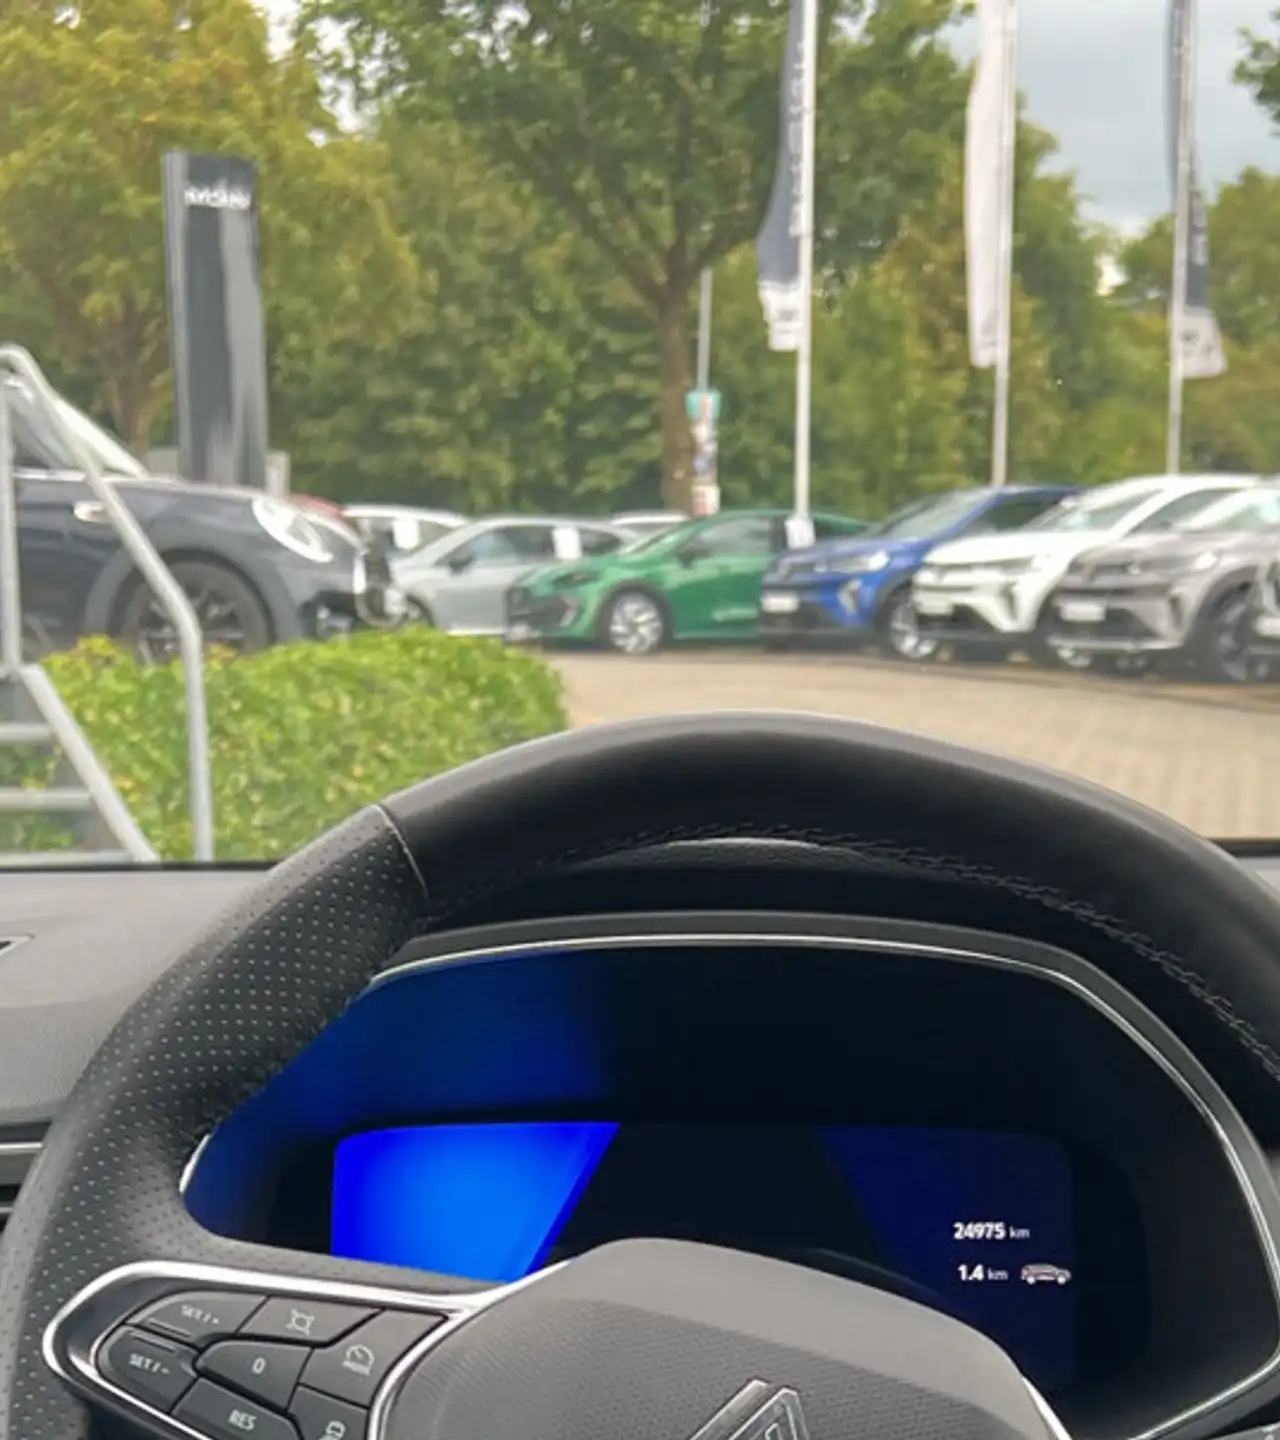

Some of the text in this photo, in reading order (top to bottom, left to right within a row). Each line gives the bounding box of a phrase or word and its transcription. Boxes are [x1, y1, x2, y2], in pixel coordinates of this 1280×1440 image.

[952, 1221, 1031, 1240] 24975 km
[957, 1263, 1009, 1281] 1.4 km
[228, 1409, 258, 1431] RES
